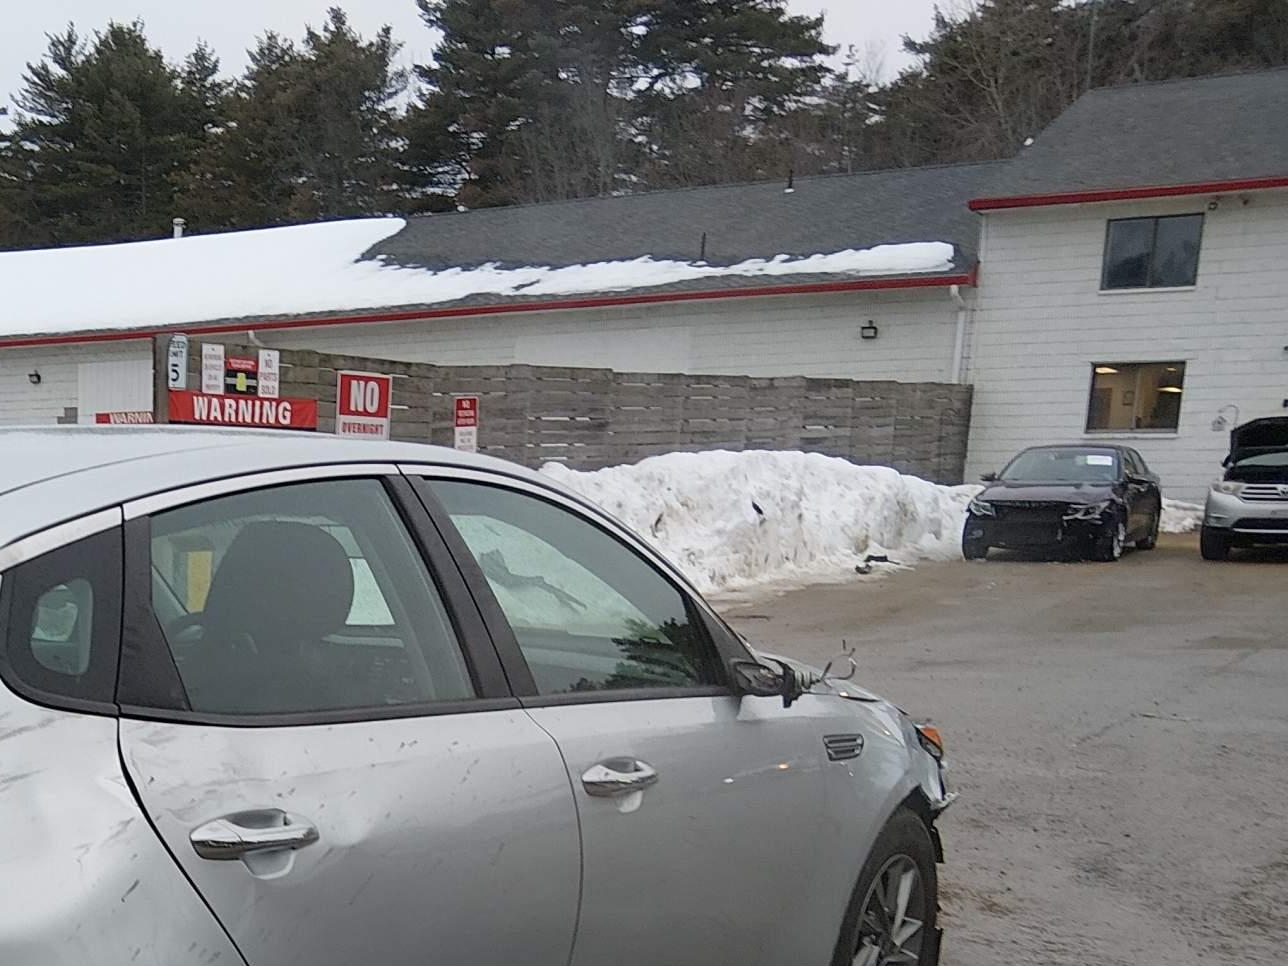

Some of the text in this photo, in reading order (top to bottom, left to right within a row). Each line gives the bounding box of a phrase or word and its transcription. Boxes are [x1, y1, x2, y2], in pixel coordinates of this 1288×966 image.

[170, 364, 179, 382] 5
[350, 380, 380, 414] NO
[192, 395, 292, 425] WARNING
[342, 422, 384, 435] OVERNIGHT
